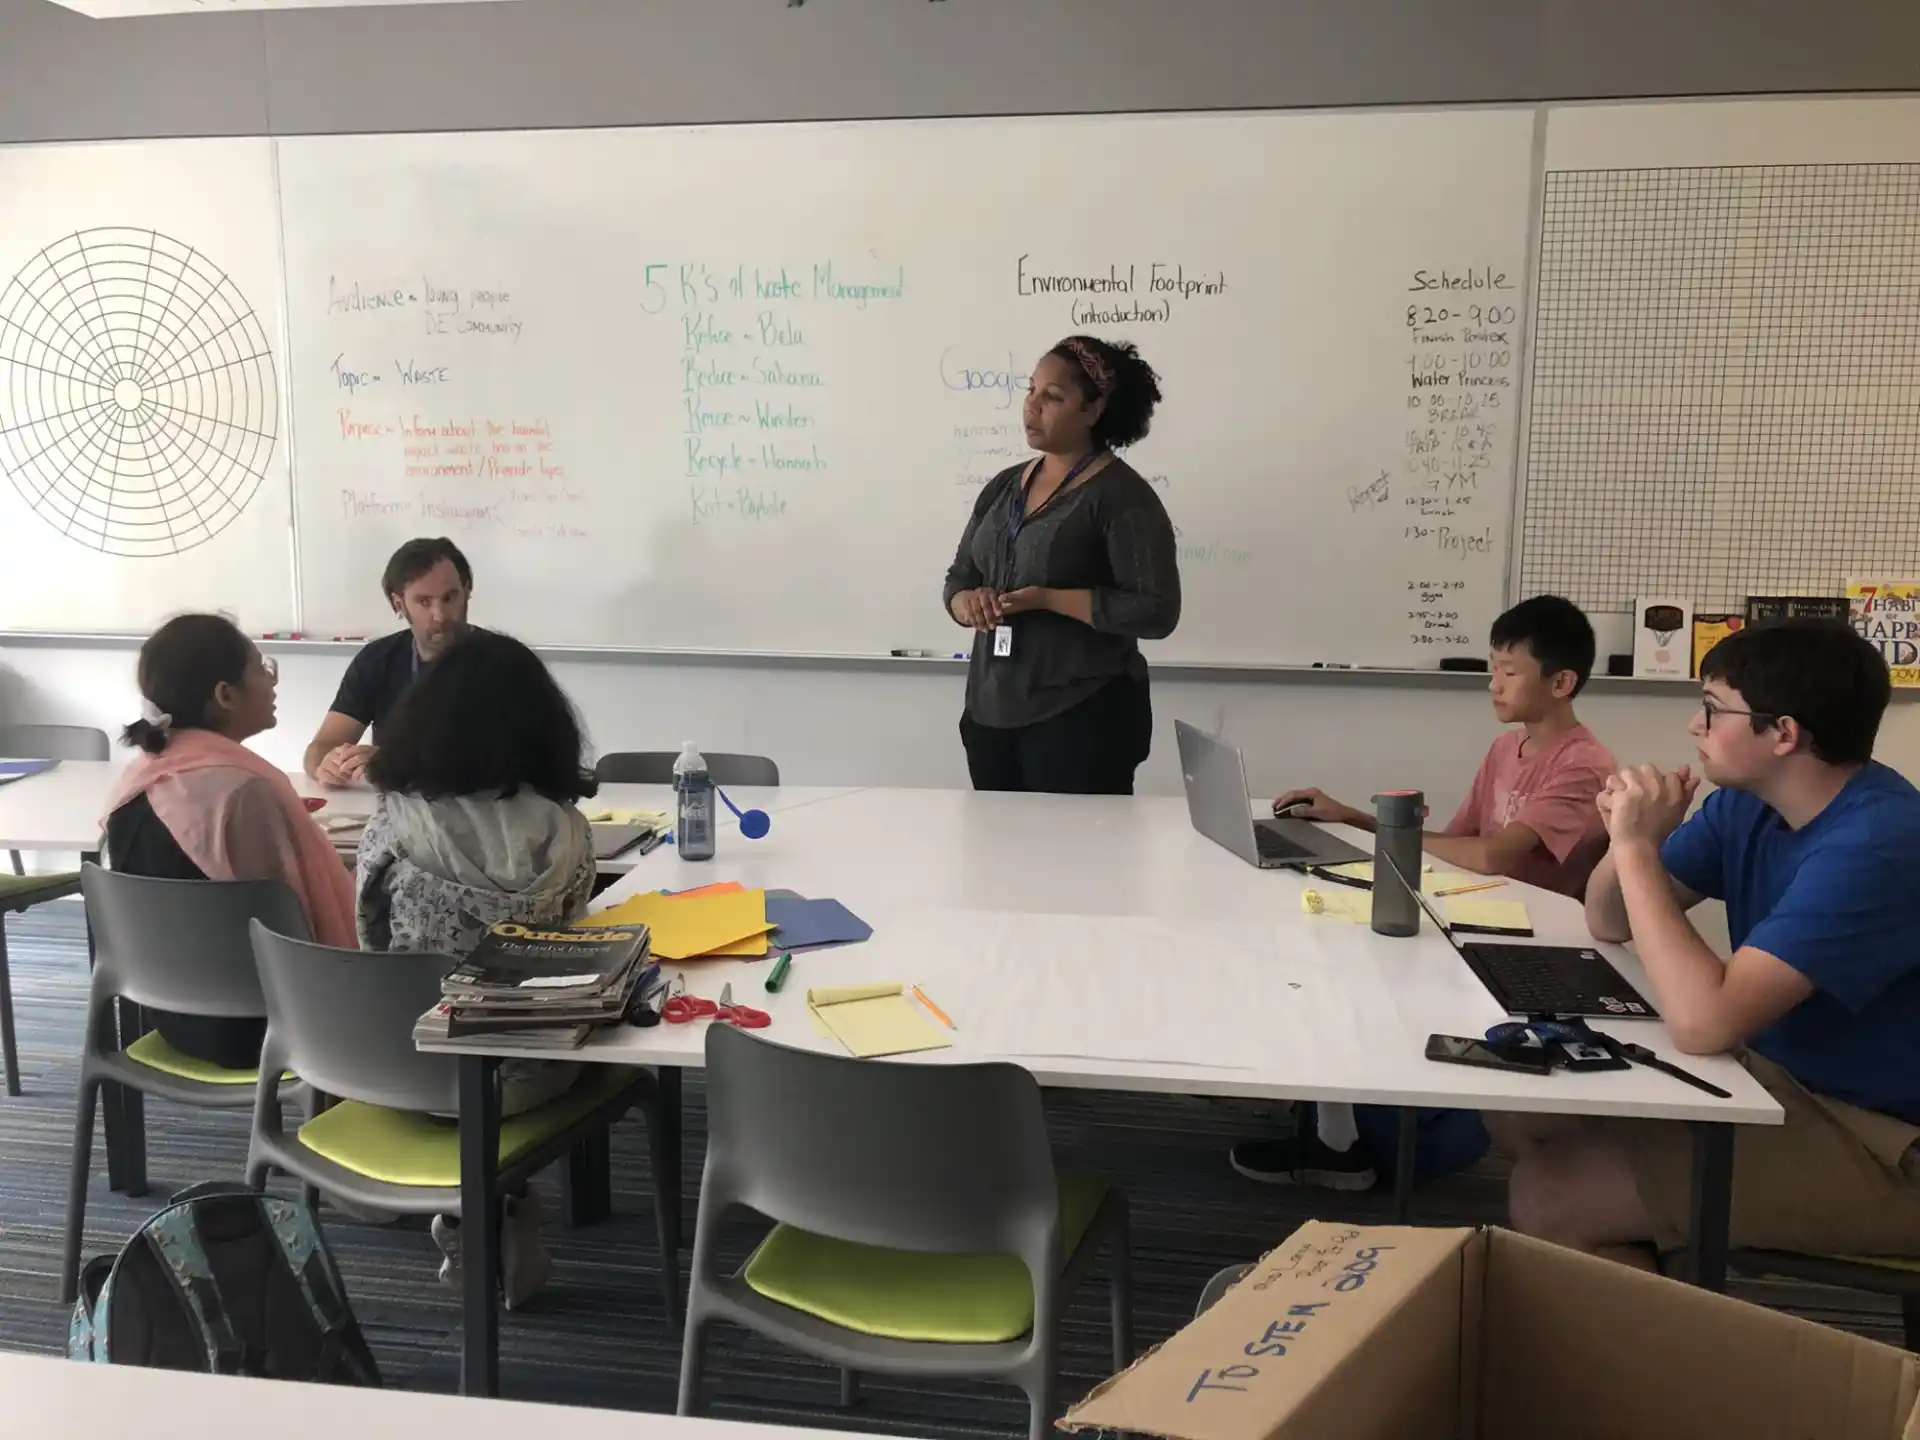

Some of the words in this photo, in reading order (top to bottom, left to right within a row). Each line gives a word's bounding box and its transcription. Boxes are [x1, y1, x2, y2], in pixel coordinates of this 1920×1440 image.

[640, 264, 668, 314] 5
[1018, 254, 1134, 296] Environmental
[1150, 263, 1229, 300] Footprint
[1409, 266, 1516, 291] Schedule
[1859, 586, 1878, 613] 7
[1873, 599, 1920, 613] HABI
[1851, 620, 1920, 639] HAPP
[1876, 641, 1920, 665] ID
